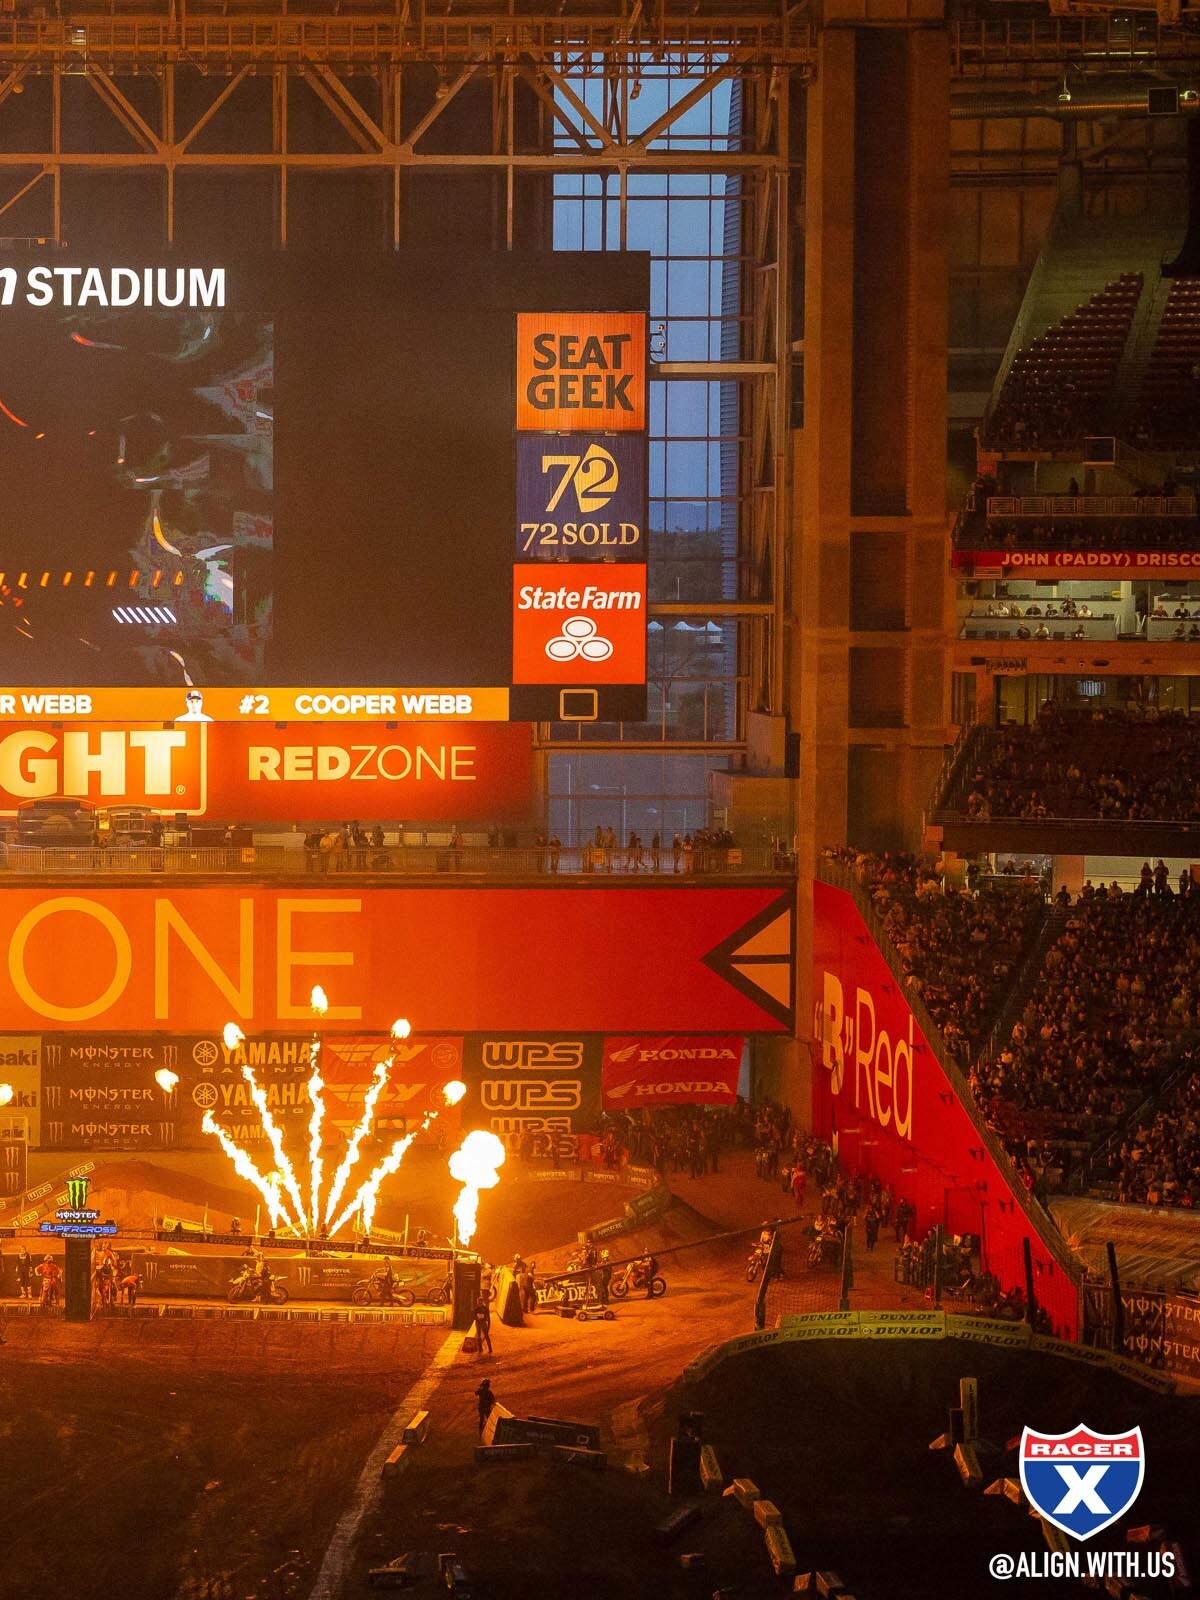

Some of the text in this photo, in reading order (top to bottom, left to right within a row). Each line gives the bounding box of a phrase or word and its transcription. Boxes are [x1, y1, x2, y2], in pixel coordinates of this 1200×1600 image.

[26, 267, 225, 306] STADIUM
[533, 333, 631, 370] SEAT
[526, 374, 634, 411] GEEK
[541, 444, 619, 513] 72
[1001, 553, 1049, 566] JOHN
[1055, 553, 1131, 567] (PADDY)
[21, 694, 92, 714] WEBB
[239, 695, 472, 715] #2 COOPER WEBB
[249, 745, 477, 781] REDZONE
[70, 1045, 154, 1060] MONSTER
[220, 1042, 311, 1064] YAMAHA
[482, 1042, 584, 1069] WPS
[638, 1048, 737, 1062] HONDA
[856, 987, 913, 1141] Red
[69, 1087, 154, 1102] MONSTER
[481, 1080, 581, 1110] WPS
[636, 1081, 734, 1095] HONDA
[71, 1122, 152, 1136] MONSTER
[56, 1210, 98, 1219] MONSTER
[41, 1224, 118, 1234] SUPERCROSS
[800, 1313, 852, 1322] DUNLOP
[879, 1313, 937, 1321] DUNLOP
[797, 1327, 858, 1338] DUNLOP
[875, 1326, 943, 1336] DUNLOP
[961, 1331, 1026, 1347] DUNLOP
